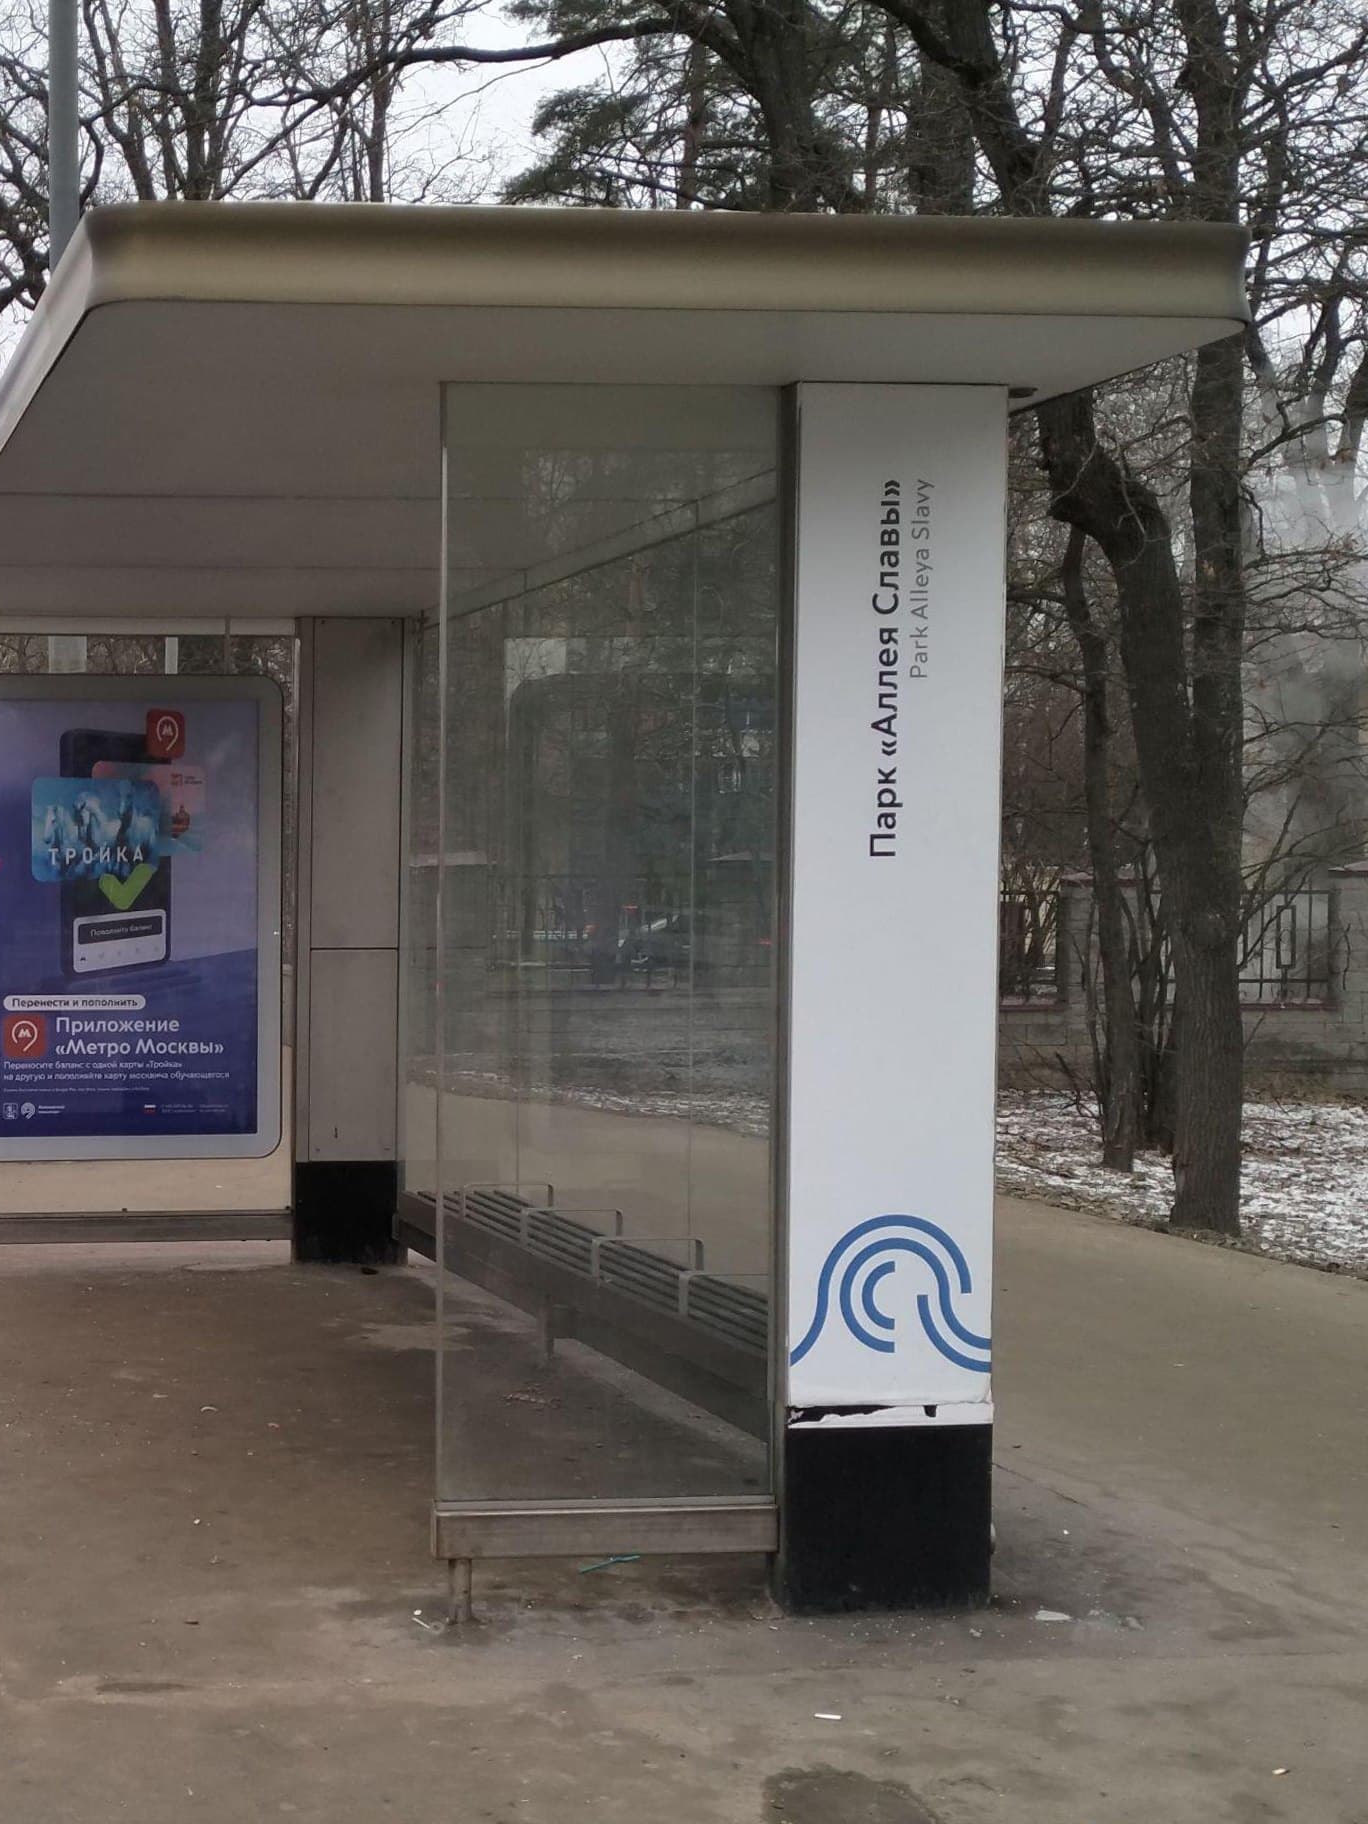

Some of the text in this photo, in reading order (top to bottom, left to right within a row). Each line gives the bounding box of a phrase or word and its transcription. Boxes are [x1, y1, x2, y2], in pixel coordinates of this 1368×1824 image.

[909, 478, 936, 678] Park Alleya Slavy
[869, 479, 903, 857] Парк «Аллея Славы»
[47, 842, 144, 866] ТРОЙКА
[12, 997, 70, 1008] Перенести
[81, 999, 138, 1007] пополнить
[55, 1016, 180, 1036] Приложение
[55, 1037, 224, 1058] «Метро Москвы»
[119, 1061, 144, 1070] карты
